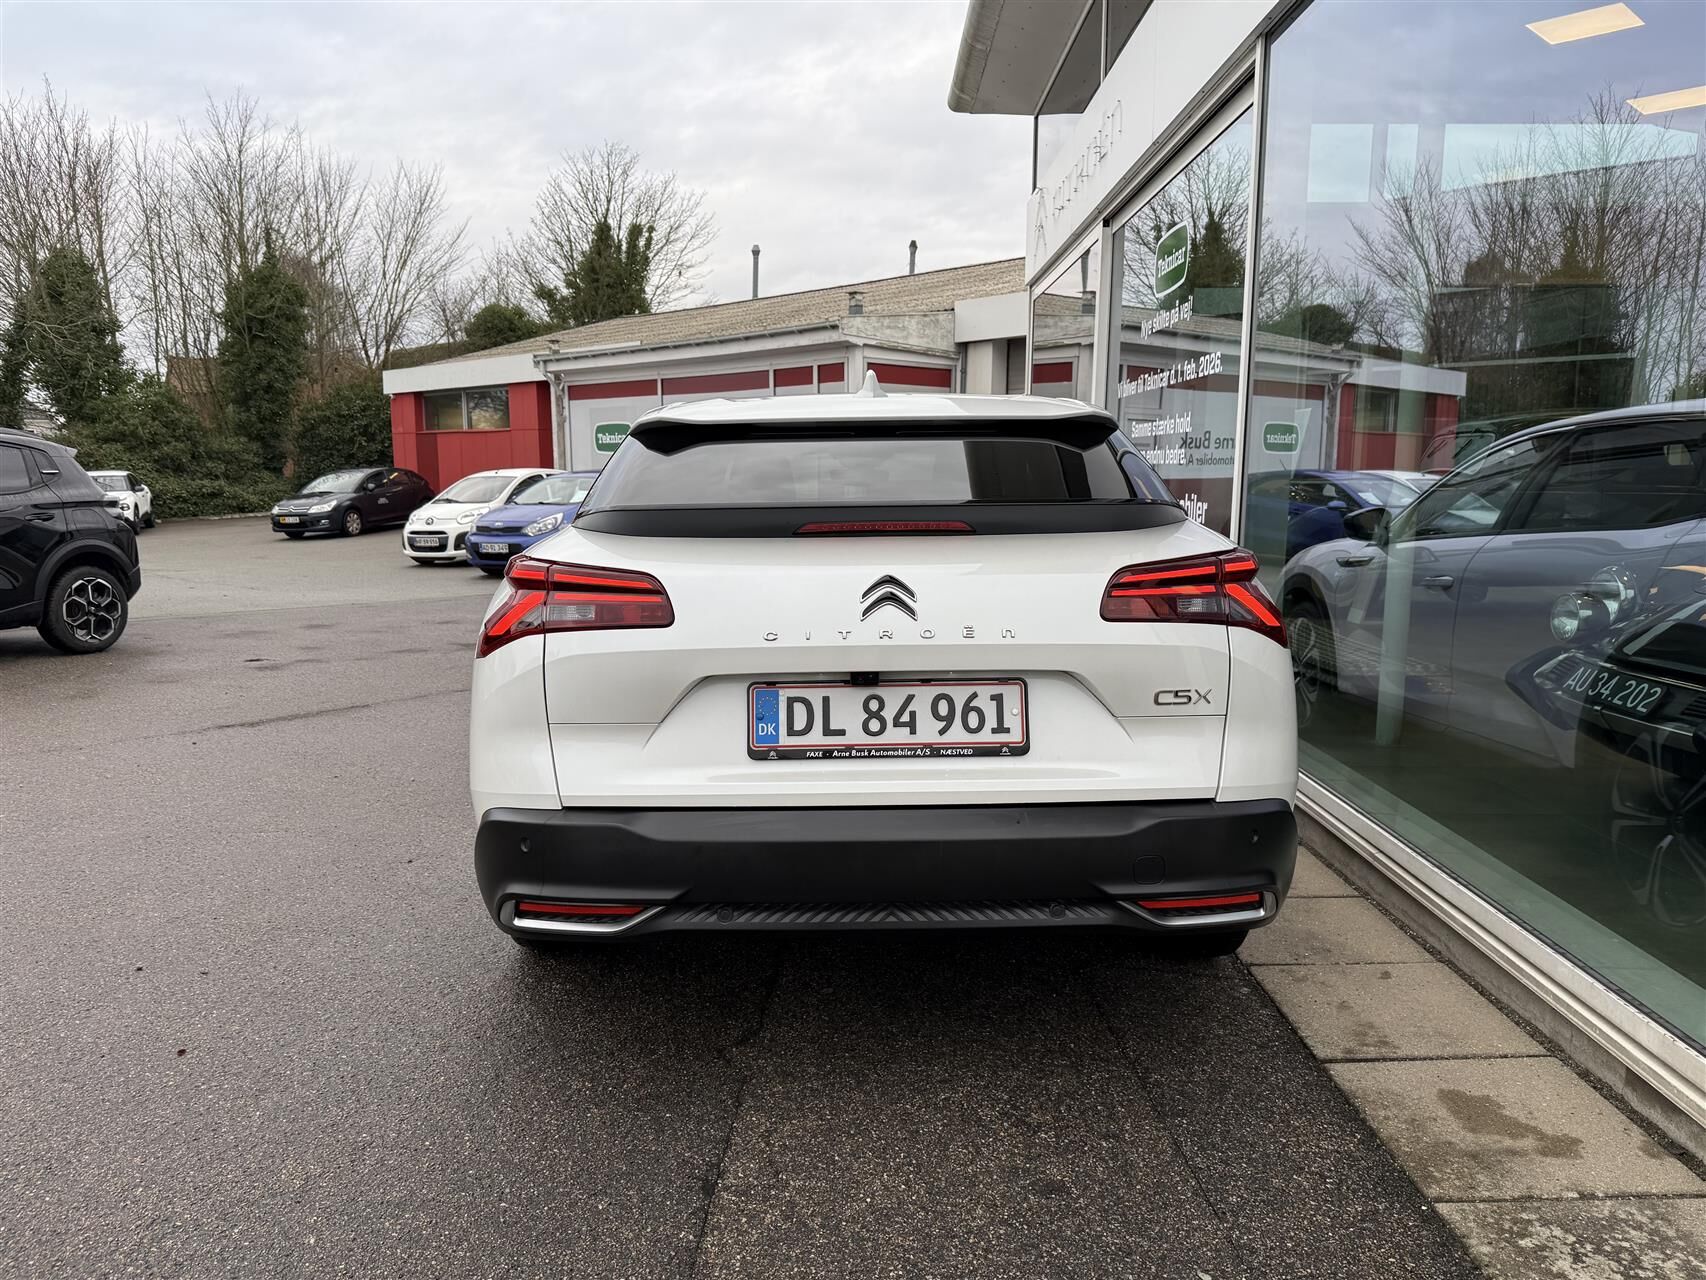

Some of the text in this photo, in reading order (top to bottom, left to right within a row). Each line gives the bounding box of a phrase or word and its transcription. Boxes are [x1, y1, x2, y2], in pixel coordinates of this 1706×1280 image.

[1158, 246, 1186, 278] Teknicar
[1141, 295, 1193, 340] Nye skilte på vej!
[1144, 369, 1169, 392] Teknicar
[1183, 358, 1198, 382] feb.
[1199, 351, 1222, 377] 2026.
[1132, 411, 1192, 437] Samme stærke hold.
[1164, 443, 1187, 465] bedre.
[785, 690, 1011, 738] DL 84 961
[758, 722, 777, 736] DK
[832, 749, 850, 757] Arne
[851, 749, 869, 757] Busk
[870, 748, 915, 756] Automobiler
[915, 748, 931, 756] A/S
[940, 748, 974, 756] NÆSTVED
